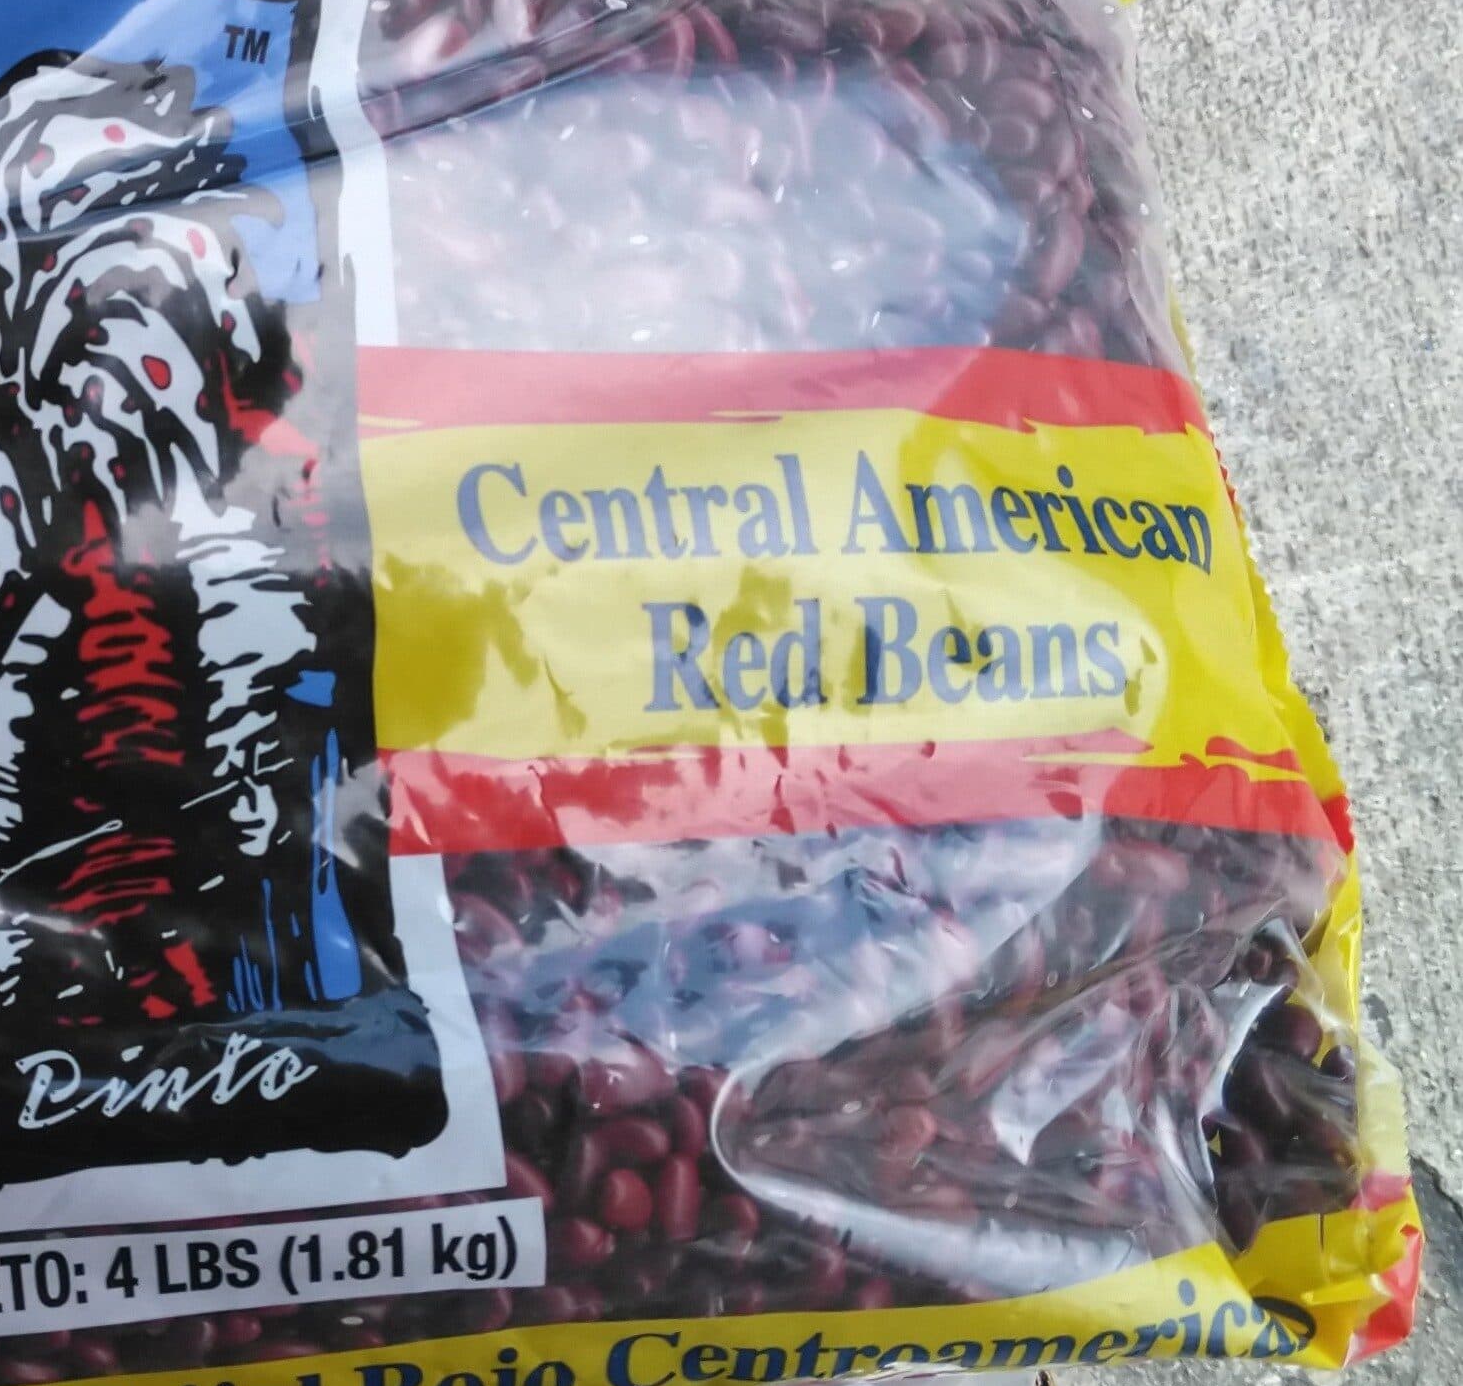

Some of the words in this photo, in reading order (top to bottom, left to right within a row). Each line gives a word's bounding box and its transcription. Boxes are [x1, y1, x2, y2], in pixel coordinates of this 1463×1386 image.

[223, 23, 272, 65] TM
[456, 451, 823, 566] Central
[842, 448, 1214, 576] American
[640, 595, 828, 714] Red
[854, 593, 1128, 707] Beans
[105, 1245, 141, 1300] 4
[156, 1232, 262, 1294] LBS
[278, 1222, 407, 1295] (1.81
[432, 1214, 521, 1285] kg)
